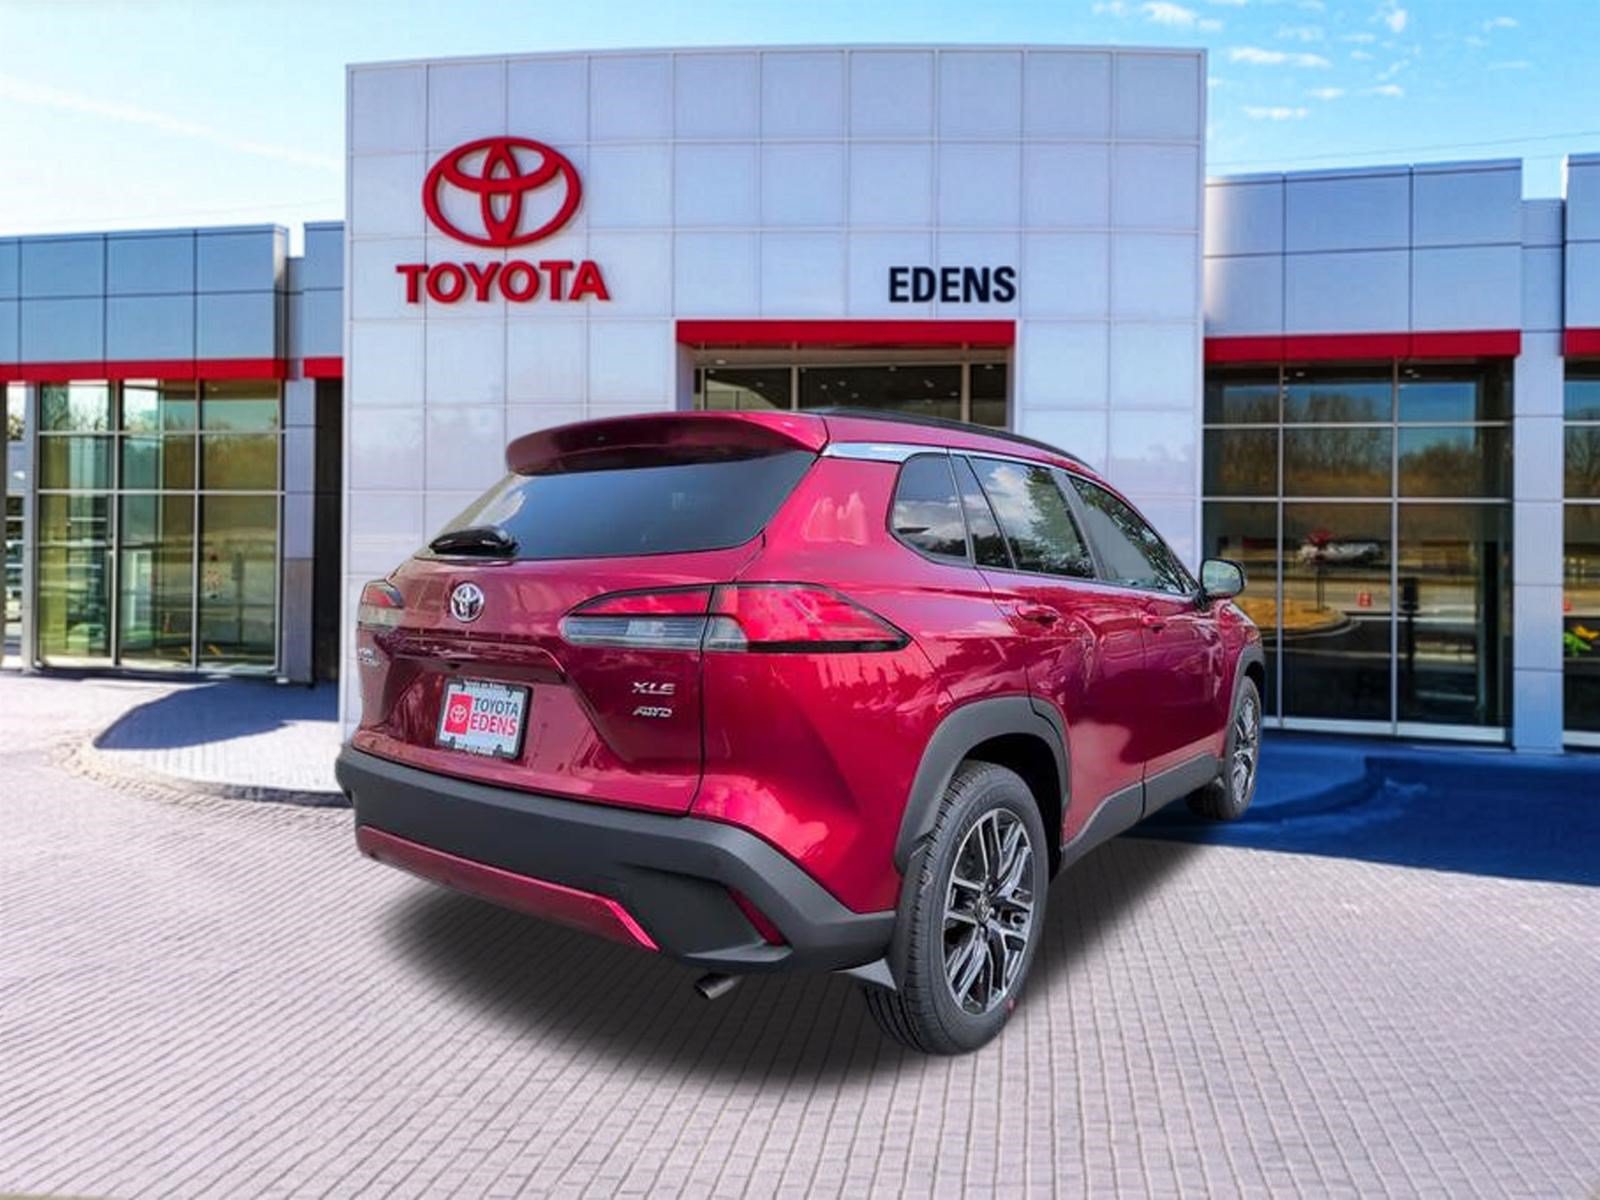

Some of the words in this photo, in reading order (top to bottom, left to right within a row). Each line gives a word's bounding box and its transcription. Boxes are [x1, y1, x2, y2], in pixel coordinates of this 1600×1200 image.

[396, 260, 610, 304] TOYOTA
[889, 266, 1017, 303] EDENS
[632, 681, 675, 695] XLE
[474, 697, 520, 716] TOYOTA
[632, 706, 673, 718] AWD
[470, 713, 518, 737] EDENS
